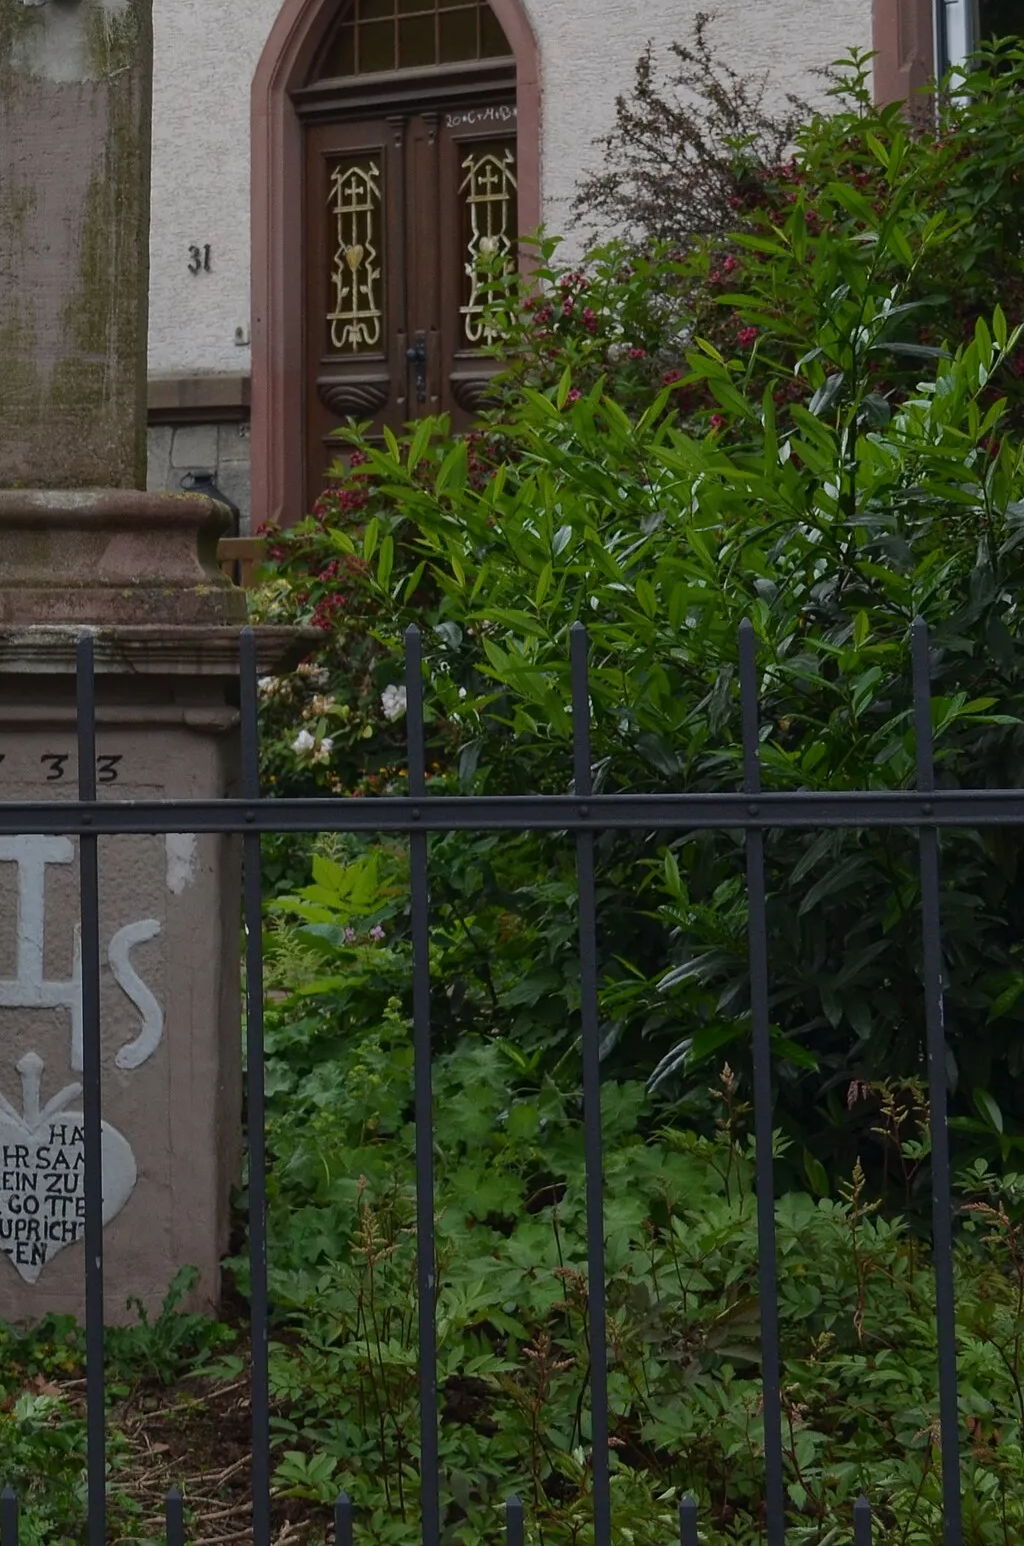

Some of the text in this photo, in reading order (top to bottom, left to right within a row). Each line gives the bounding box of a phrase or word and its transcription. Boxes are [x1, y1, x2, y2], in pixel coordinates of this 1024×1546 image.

[187, 243, 212, 277] 31
[49, 1123, 103, 1146] HA
[7, 1193, 104, 1218] GOTTE
